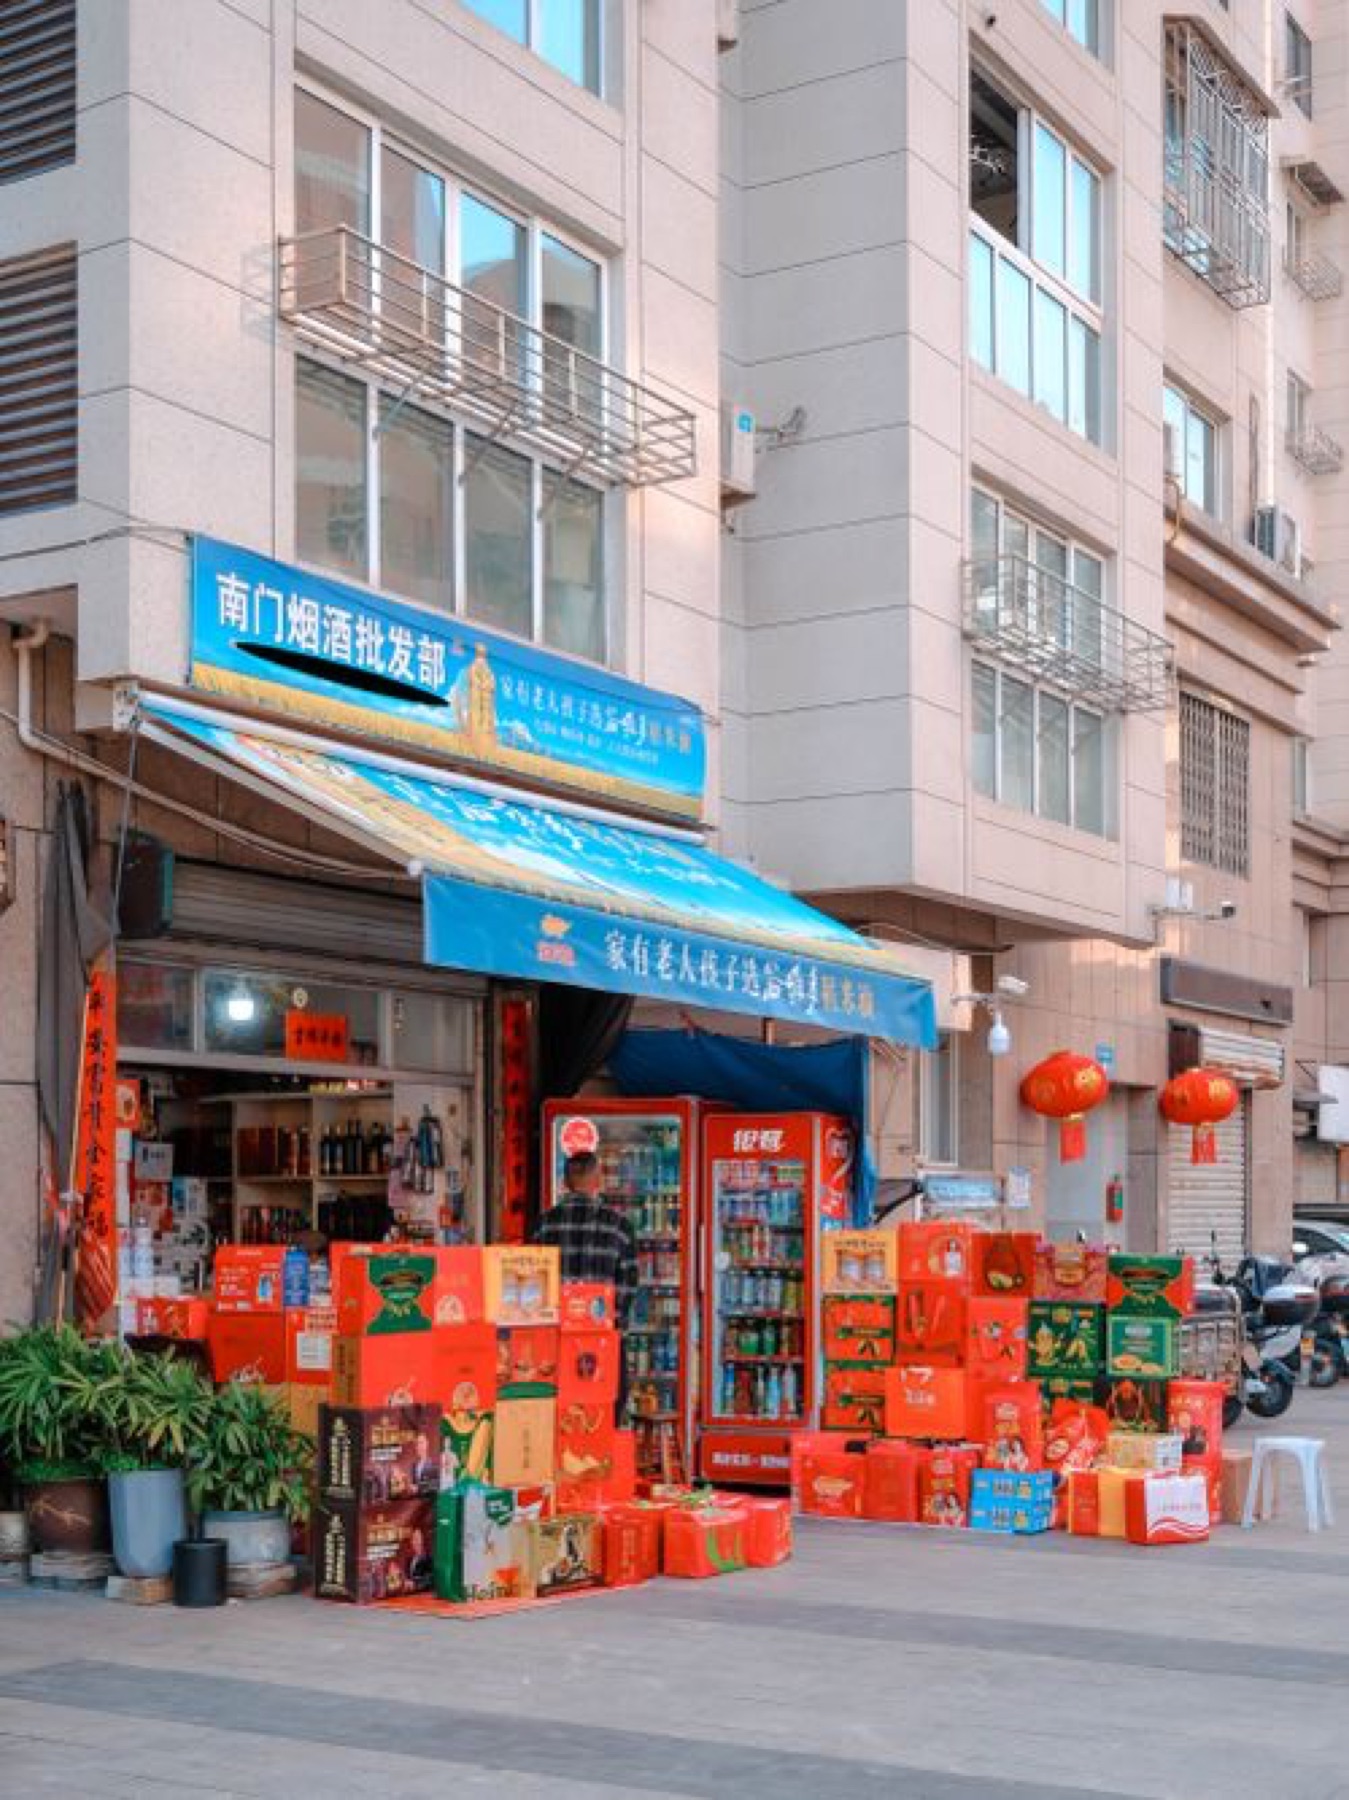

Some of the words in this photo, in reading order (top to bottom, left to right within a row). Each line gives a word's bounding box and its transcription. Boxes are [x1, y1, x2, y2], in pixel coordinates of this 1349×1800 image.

[216, 572, 446, 691] 南门烟酒批发部
